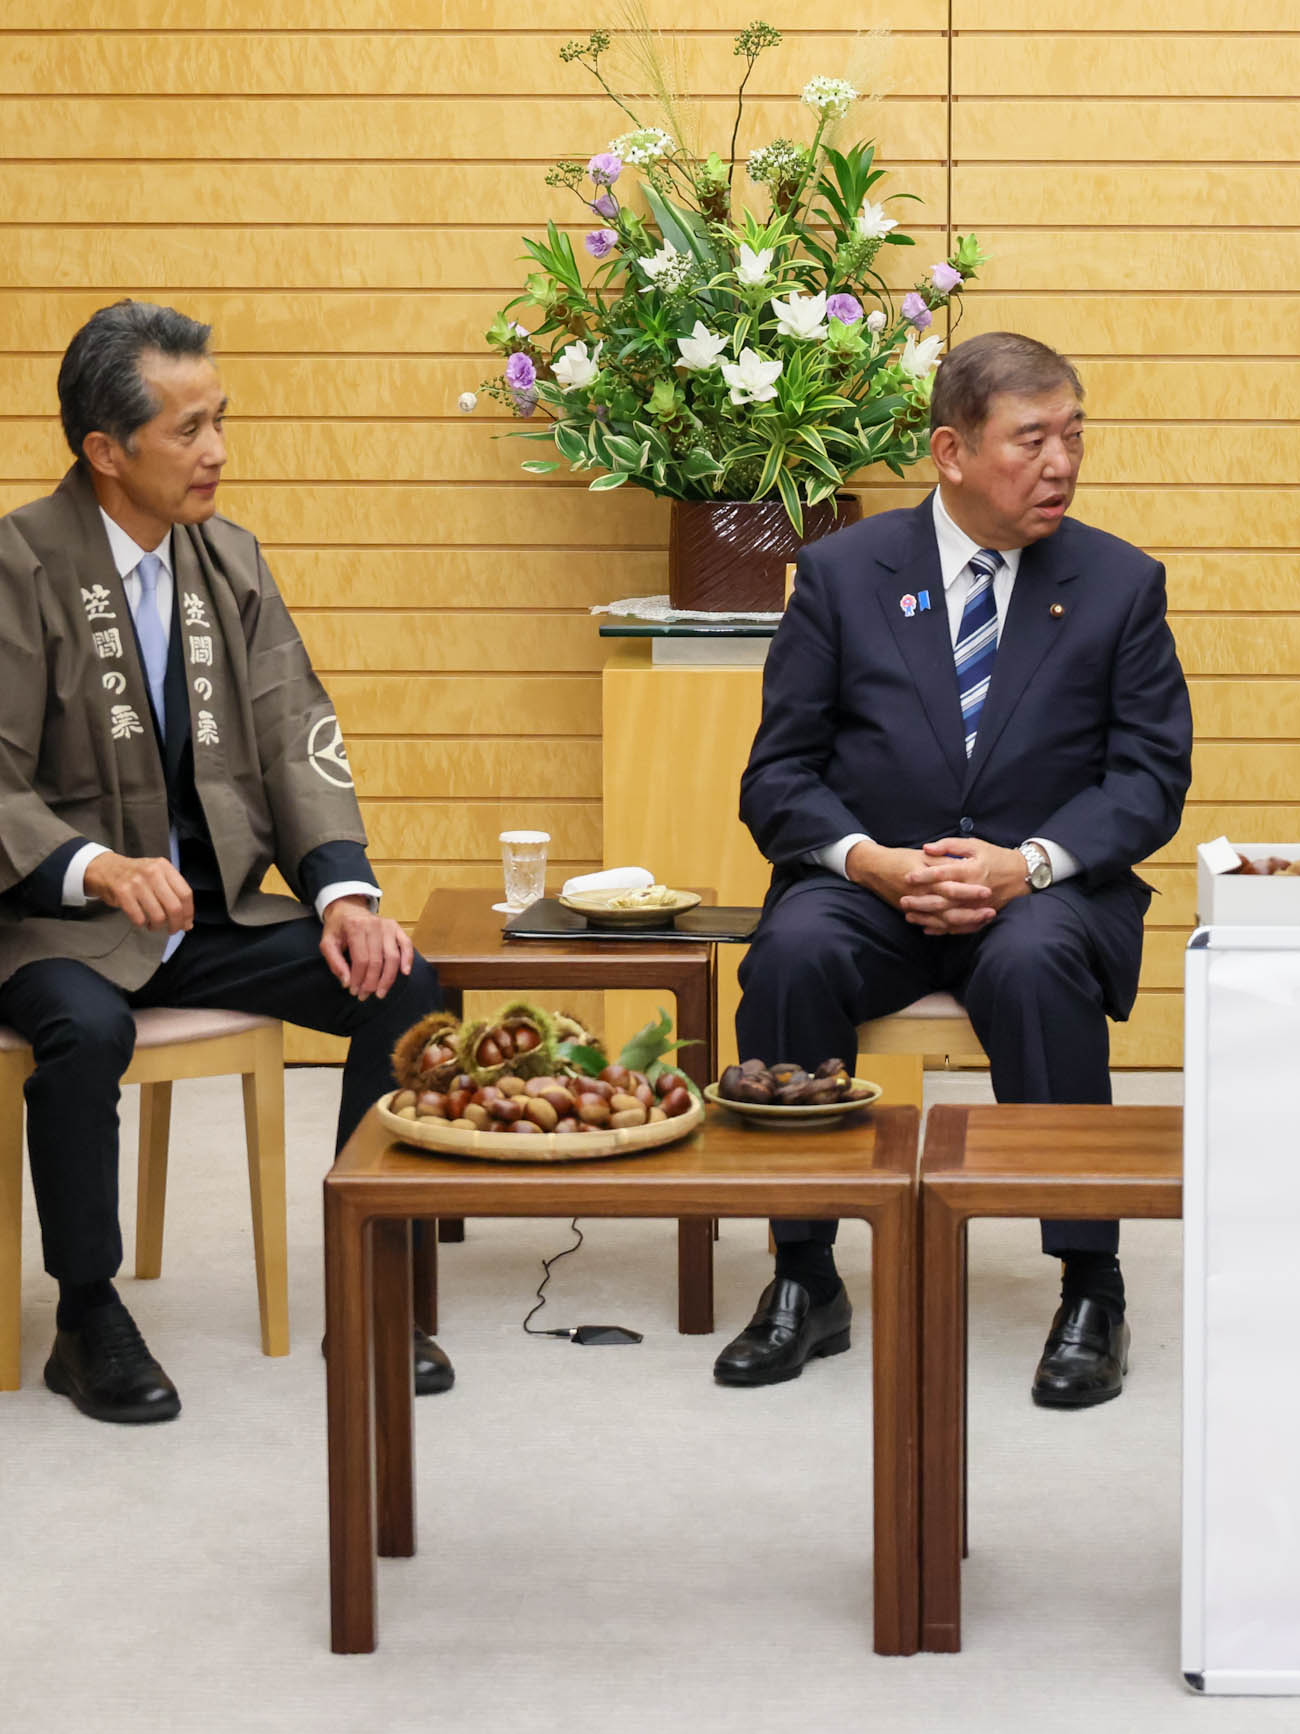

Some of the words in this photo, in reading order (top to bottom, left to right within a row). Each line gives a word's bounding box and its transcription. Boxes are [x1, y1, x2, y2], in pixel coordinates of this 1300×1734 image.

[80, 583, 144, 740] 笠間の栗
[183, 592, 220, 746] 笠間の栗
